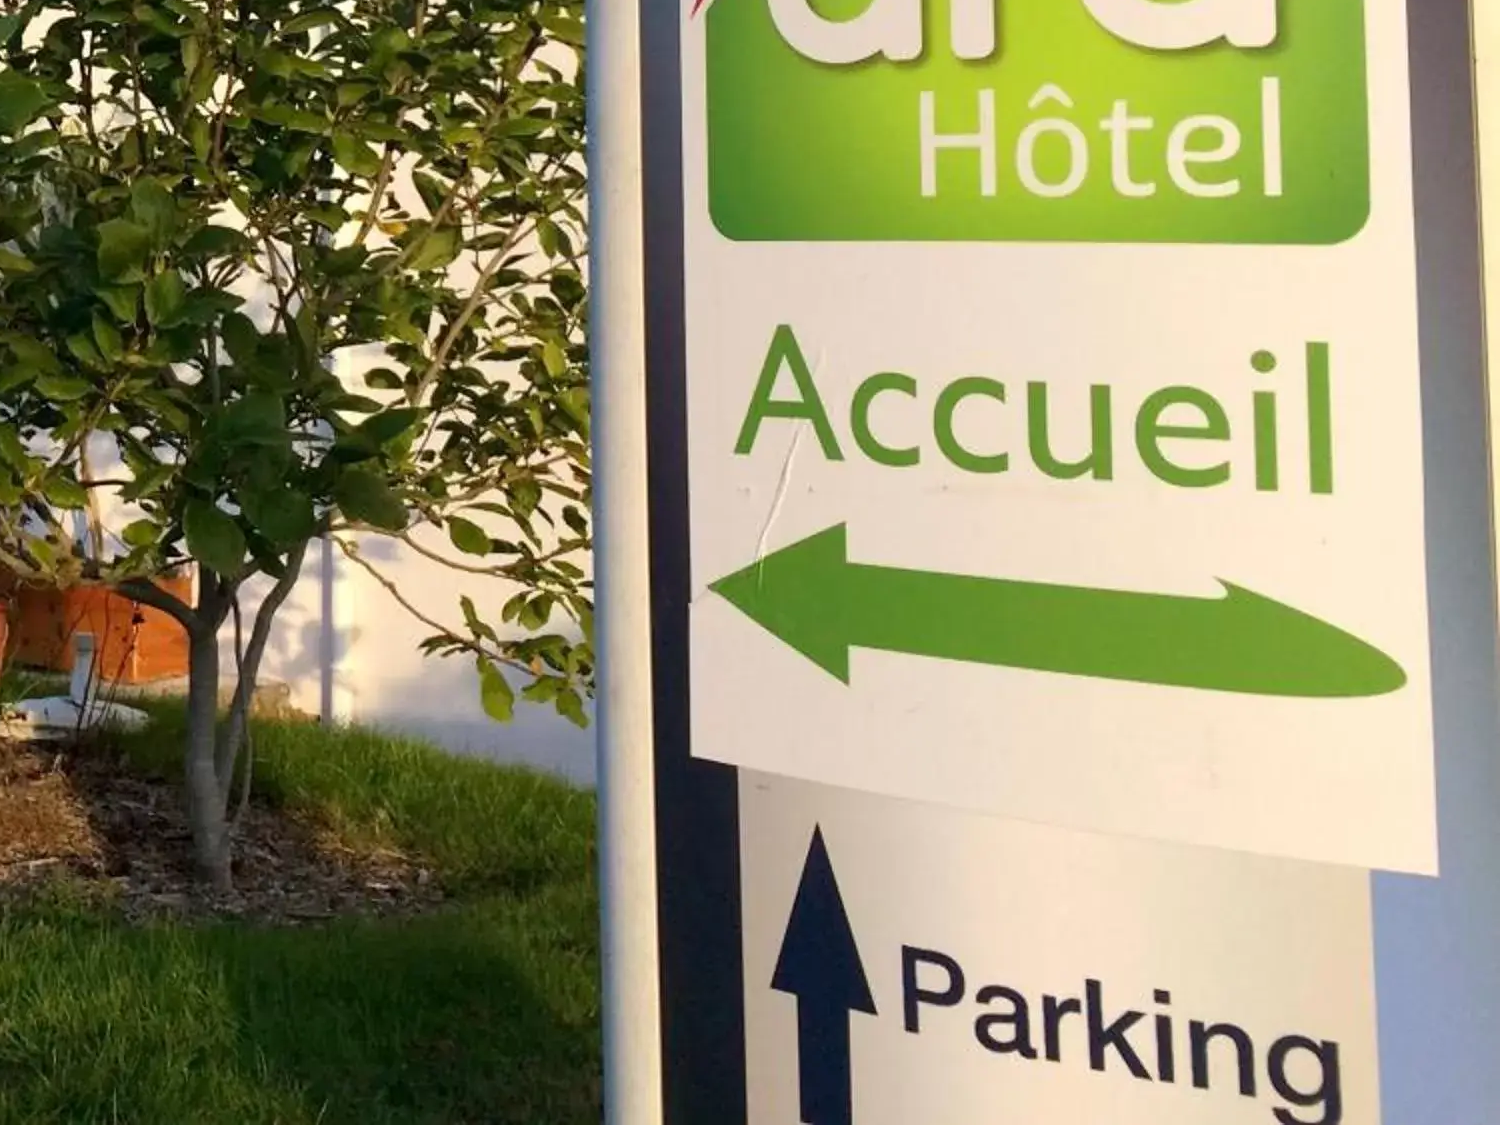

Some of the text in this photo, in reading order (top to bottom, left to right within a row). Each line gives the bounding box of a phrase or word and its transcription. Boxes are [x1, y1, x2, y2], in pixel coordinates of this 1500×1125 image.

[919, 76, 1284, 199] Hôtel
[733, 323, 1335, 495] Accueil
[901, 944, 1342, 1125] Parking
